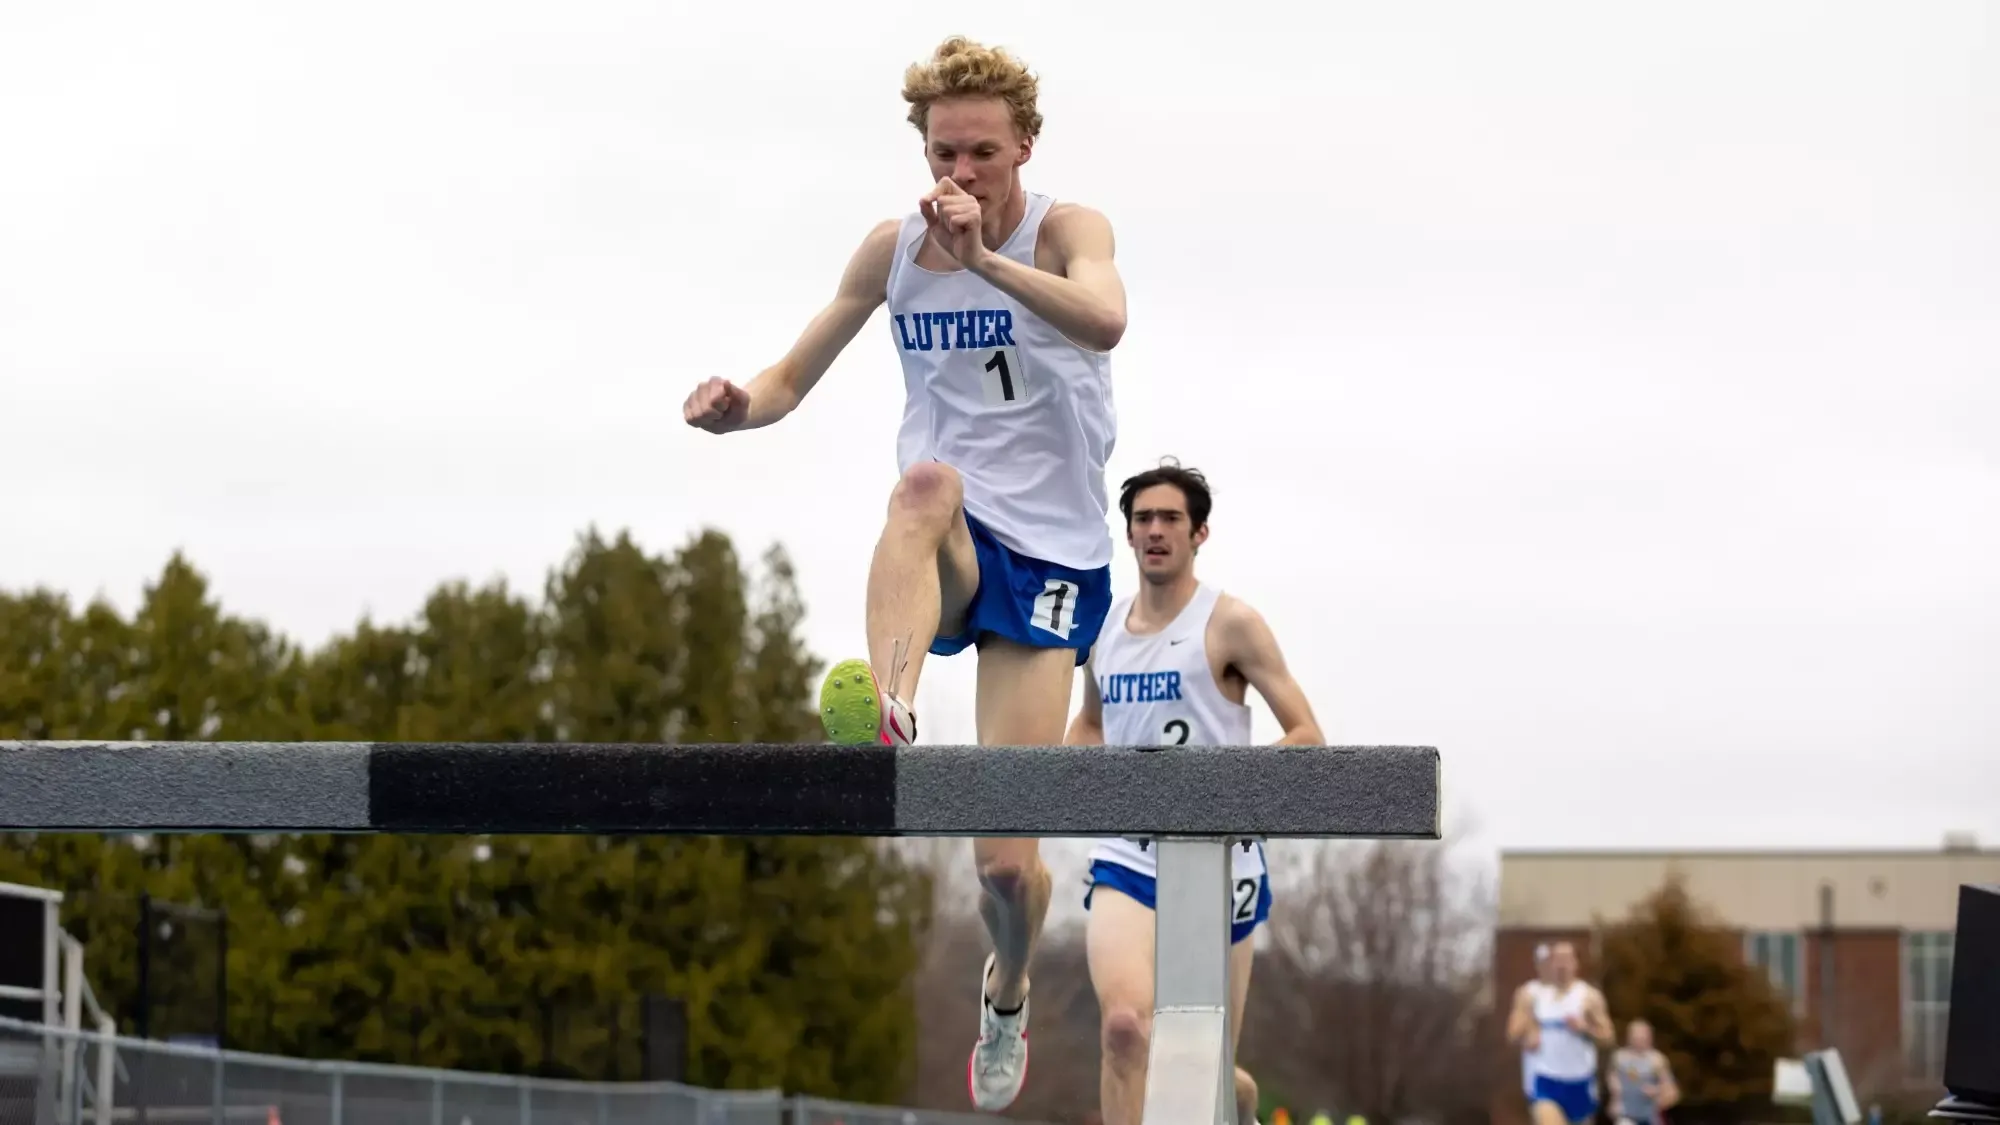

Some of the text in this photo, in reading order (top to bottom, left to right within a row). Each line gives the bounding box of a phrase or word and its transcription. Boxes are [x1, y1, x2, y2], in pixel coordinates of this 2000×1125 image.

[894, 309, 1017, 351] LUTHER
[984, 350, 1015, 401] 1
[1043, 583, 1069, 630] 1
[1100, 671, 1182, 704] LUTHER
[1163, 719, 1190, 745] 2
[1236, 878, 1256, 920] 2
